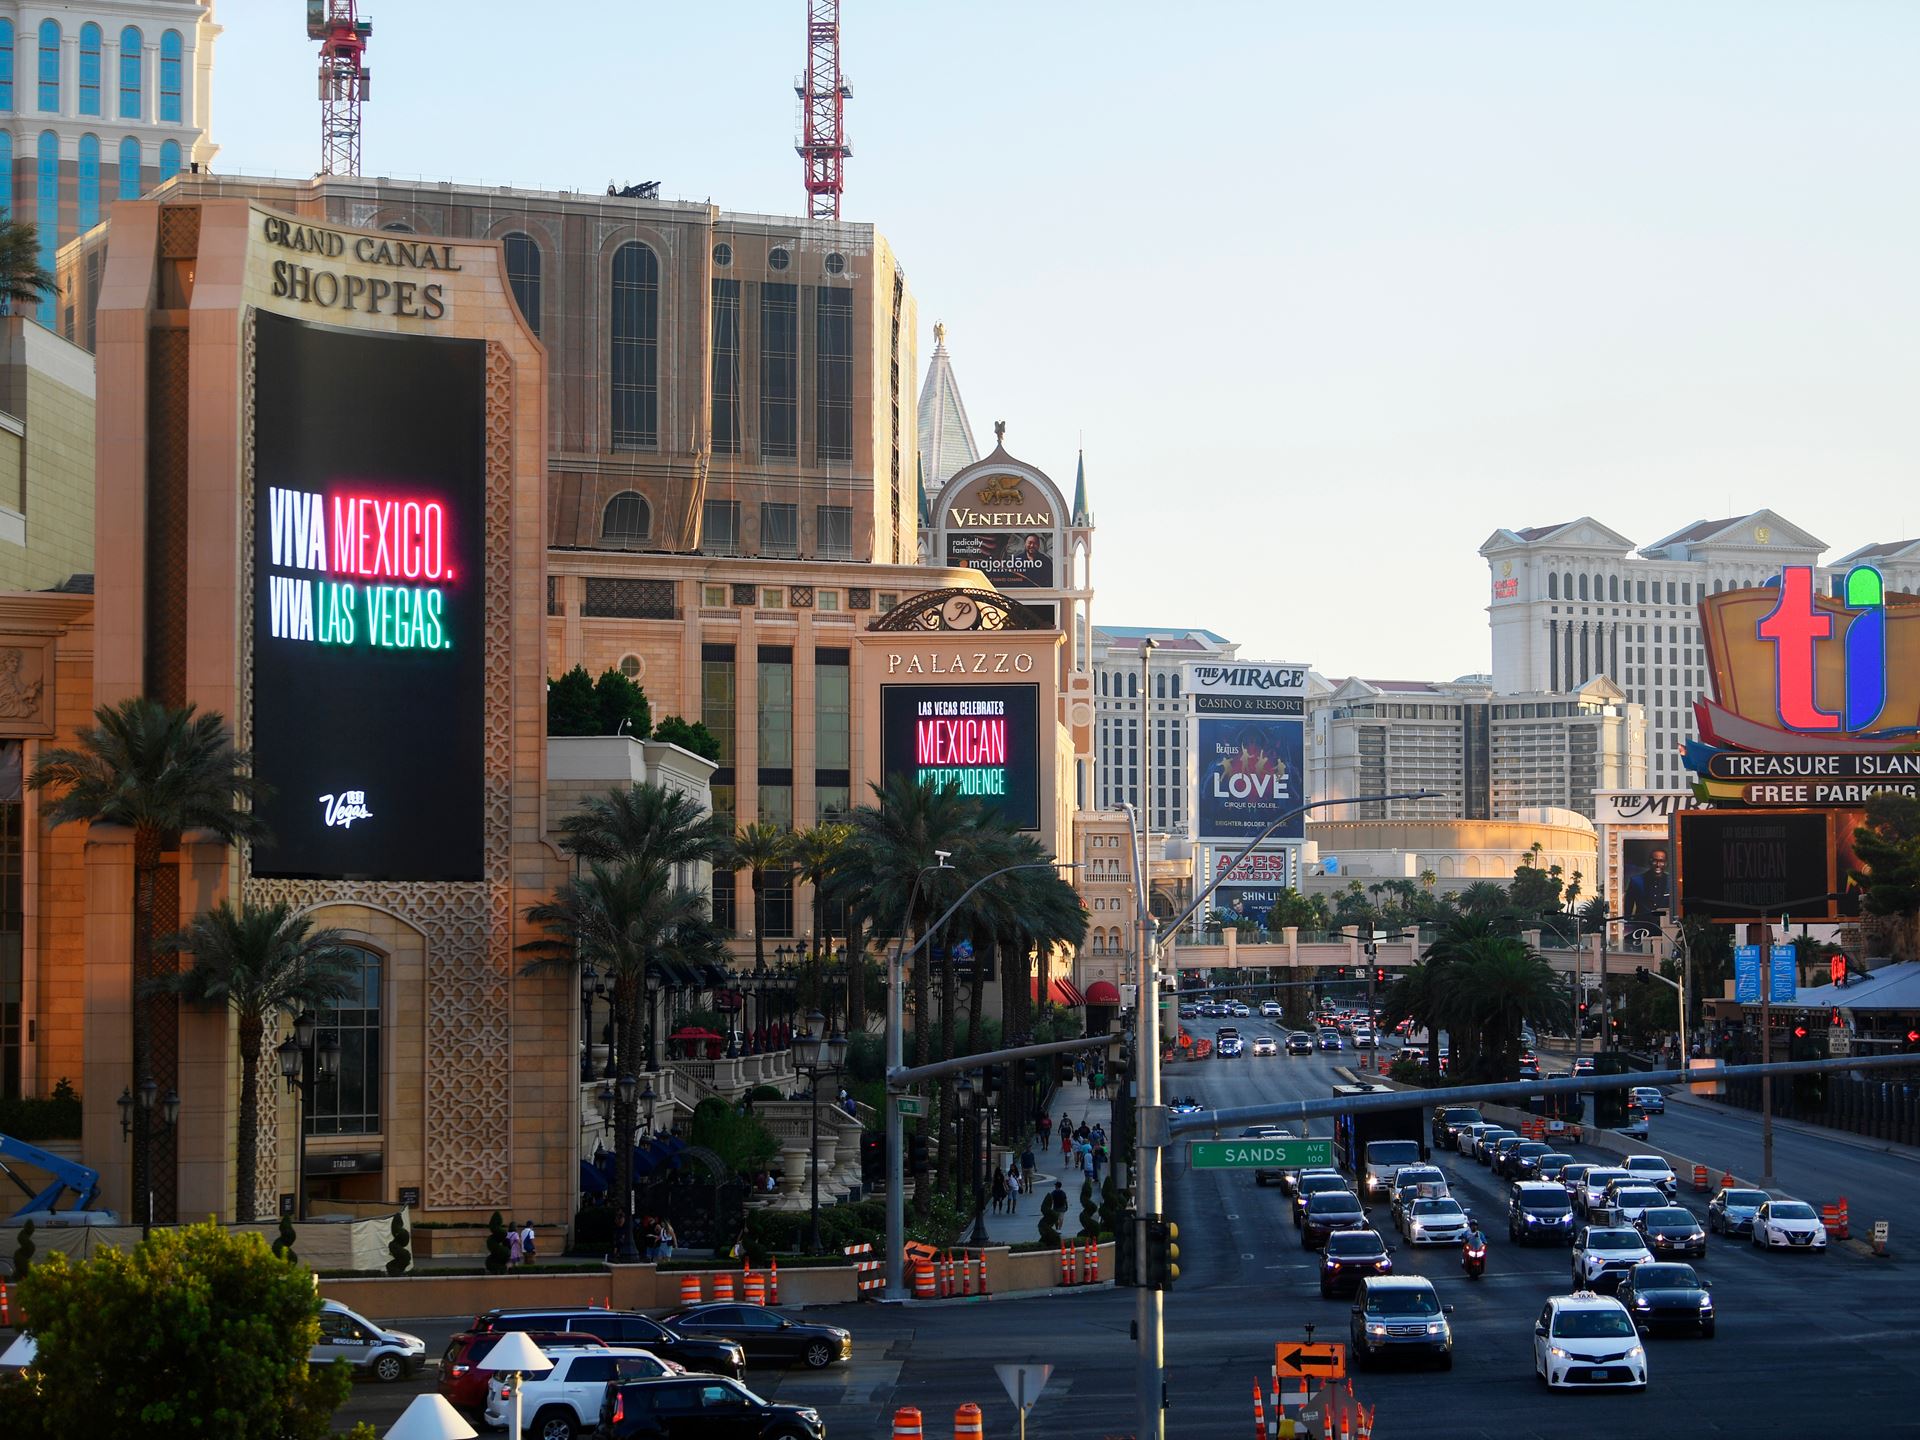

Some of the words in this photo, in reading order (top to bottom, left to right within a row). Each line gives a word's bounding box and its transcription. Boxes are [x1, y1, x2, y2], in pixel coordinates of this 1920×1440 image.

[264, 217, 345, 257] GRAND
[356, 238, 461, 271] CANAL
[272, 260, 444, 319] SHOPPES
[270, 486, 327, 571] VIVA
[334, 496, 453, 579] MEXICO.
[953, 538, 983, 547] radically
[270, 575, 314, 641] VIVA
[318, 582, 354, 644] LAS
[366, 586, 450, 649] VEGAS.
[888, 653, 1034, 673] PALAZZO
[1195, 667, 1219, 678] THE
[1202, 668, 1304, 690] MIRAGE
[918, 701, 933, 716] LAS
[934, 701, 958, 716] VEGAS
[960, 701, 1004, 716] CELEBRATES
[1199, 698, 1242, 708] CASINO
[1244, 701, 1253, 709] &
[1256, 699, 1303, 711] RESORT
[918, 720, 1004, 764] MEXICAN
[1726, 757, 1839, 775] TREASURE
[1213, 772, 1290, 799] LOVE
[1751, 786, 1808, 802] FREE
[1224, 801, 1247, 809] CIRQUE
[1610, 796, 1641, 808] THE
[1618, 795, 1714, 818] MIR
[1722, 842, 1786, 879] MEXICAN
[1242, 891, 1265, 901] SHIN
[1225, 1148, 1287, 1162] SANDS
[1306, 1144, 1325, 1152] AVE
[1307, 1155, 1324, 1163] 100
